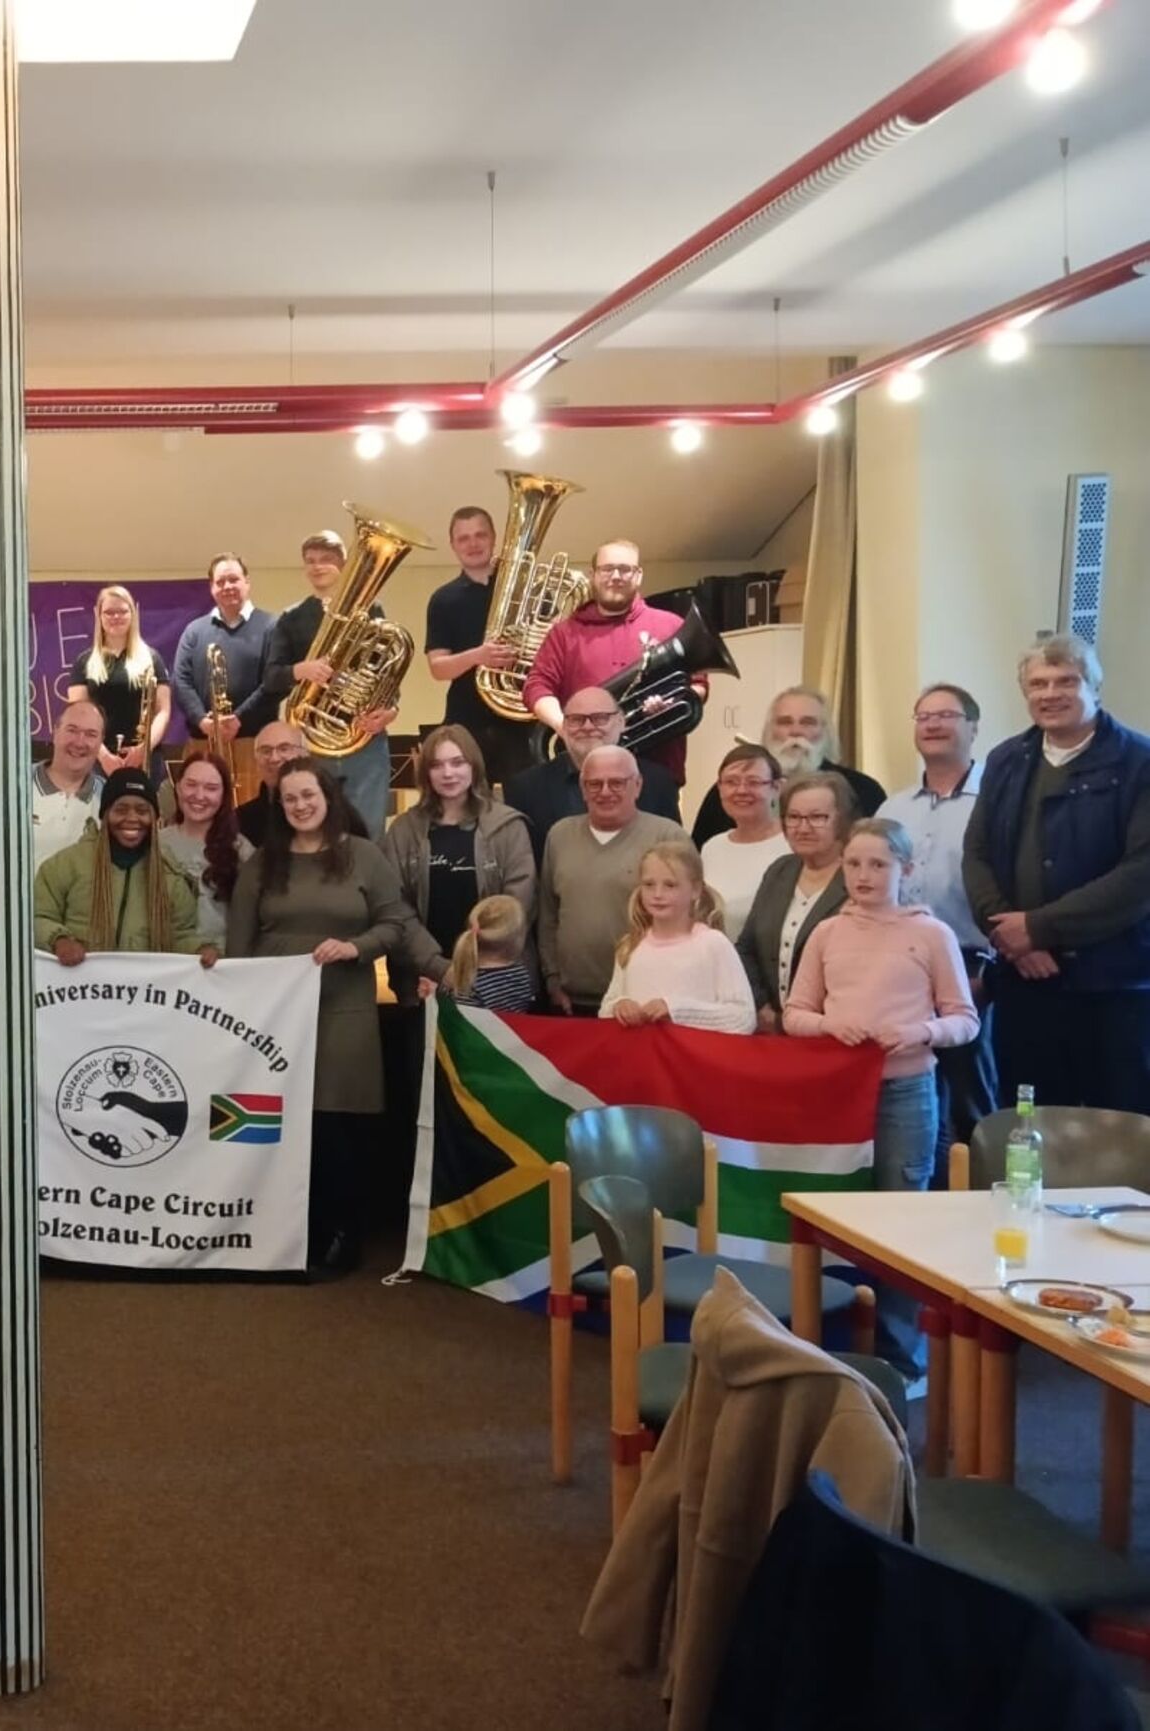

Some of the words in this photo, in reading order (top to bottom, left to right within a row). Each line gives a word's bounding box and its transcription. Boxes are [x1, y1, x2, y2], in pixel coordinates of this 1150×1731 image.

[34, 983, 139, 1009] niversary
[144, 983, 167, 1006] in
[173, 989, 289, 1074] Partnership
[74, 1068, 103, 1112] Loccum
[143, 1070, 166, 1098] Cape
[144, 1057, 178, 1098] Eastern
[38, 1185, 81, 1204] ern
[89, 1186, 156, 1215] Cape
[163, 1193, 254, 1218] Circuit
[38, 1216, 253, 1251] olzenau-Loccum
